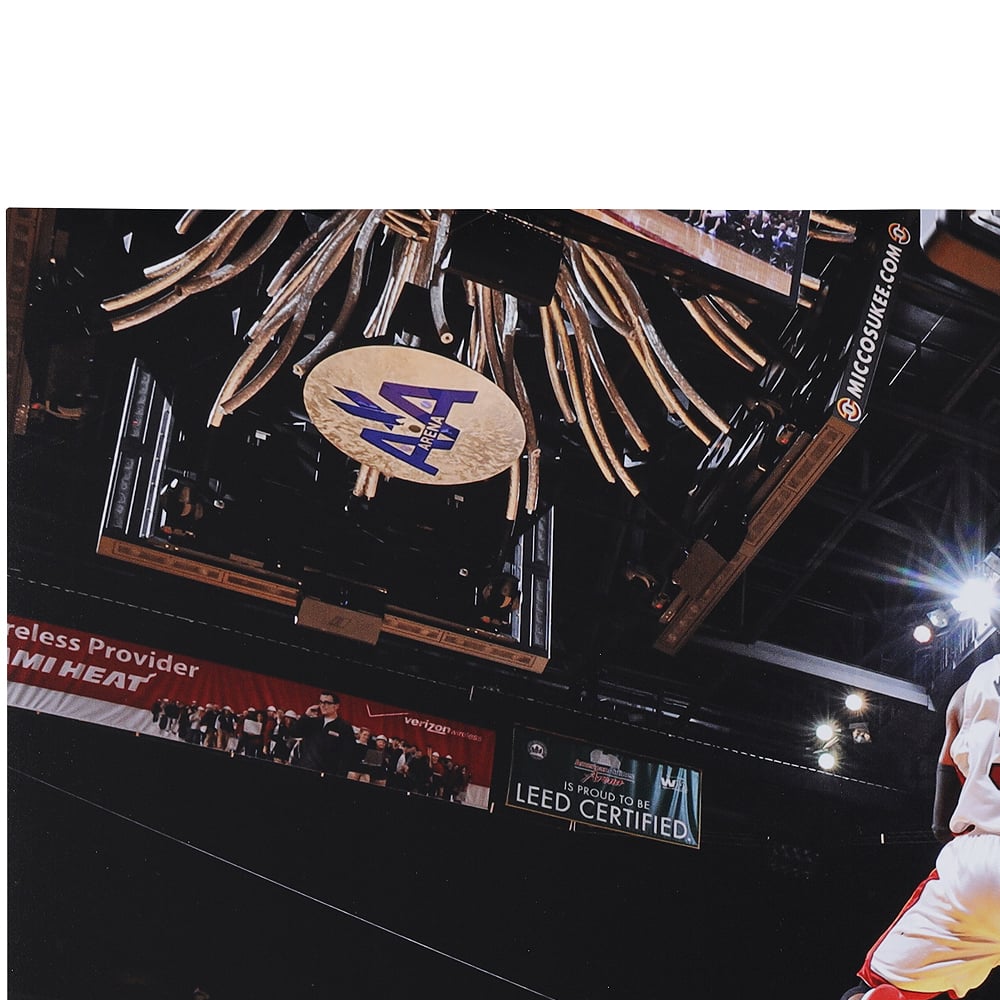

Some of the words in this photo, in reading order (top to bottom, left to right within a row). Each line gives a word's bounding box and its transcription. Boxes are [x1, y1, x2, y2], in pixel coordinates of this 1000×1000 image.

[846, 243, 903, 399] MICCOSUKEE.COM
[418, 416, 445, 451] ARENA
[88, 637, 200, 678] Provider
[58, 660, 157, 692] HEAT
[516, 782, 572, 813] LEED
[563, 780, 574, 791] IS
[577, 785, 616, 802] PROUD
[619, 794, 634, 806] TO
[637, 800, 651, 810] BE
